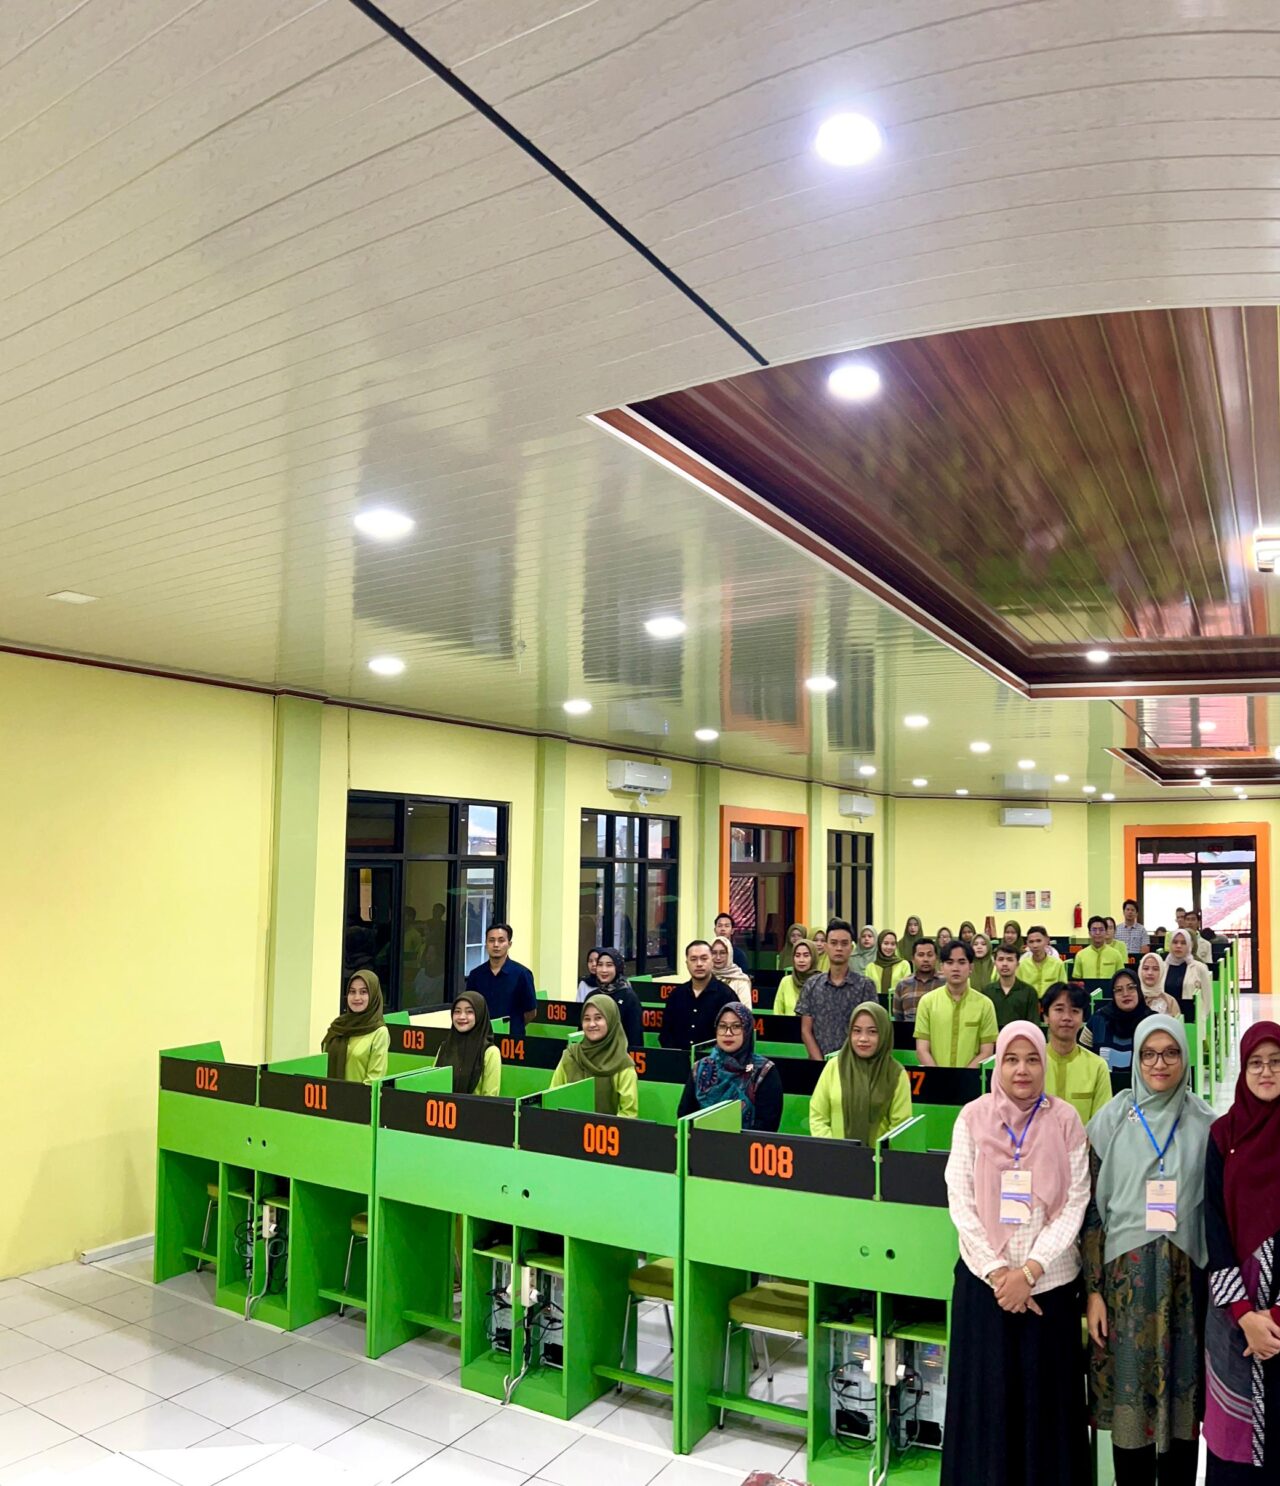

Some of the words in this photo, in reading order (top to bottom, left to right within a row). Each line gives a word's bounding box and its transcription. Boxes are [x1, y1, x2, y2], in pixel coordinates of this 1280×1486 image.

[661, 985, 676, 999] 03
[547, 1005, 567, 1020] 036
[642, 1010, 663, 1027] 035
[403, 1030, 425, 1049] 013
[501, 1039, 525, 1060] 014
[195, 1067, 218, 1091] 012
[304, 1083, 327, 1110] 011
[425, 1099, 457, 1129] 010
[583, 1122, 620, 1157] 009
[749, 1142, 794, 1179] 008
